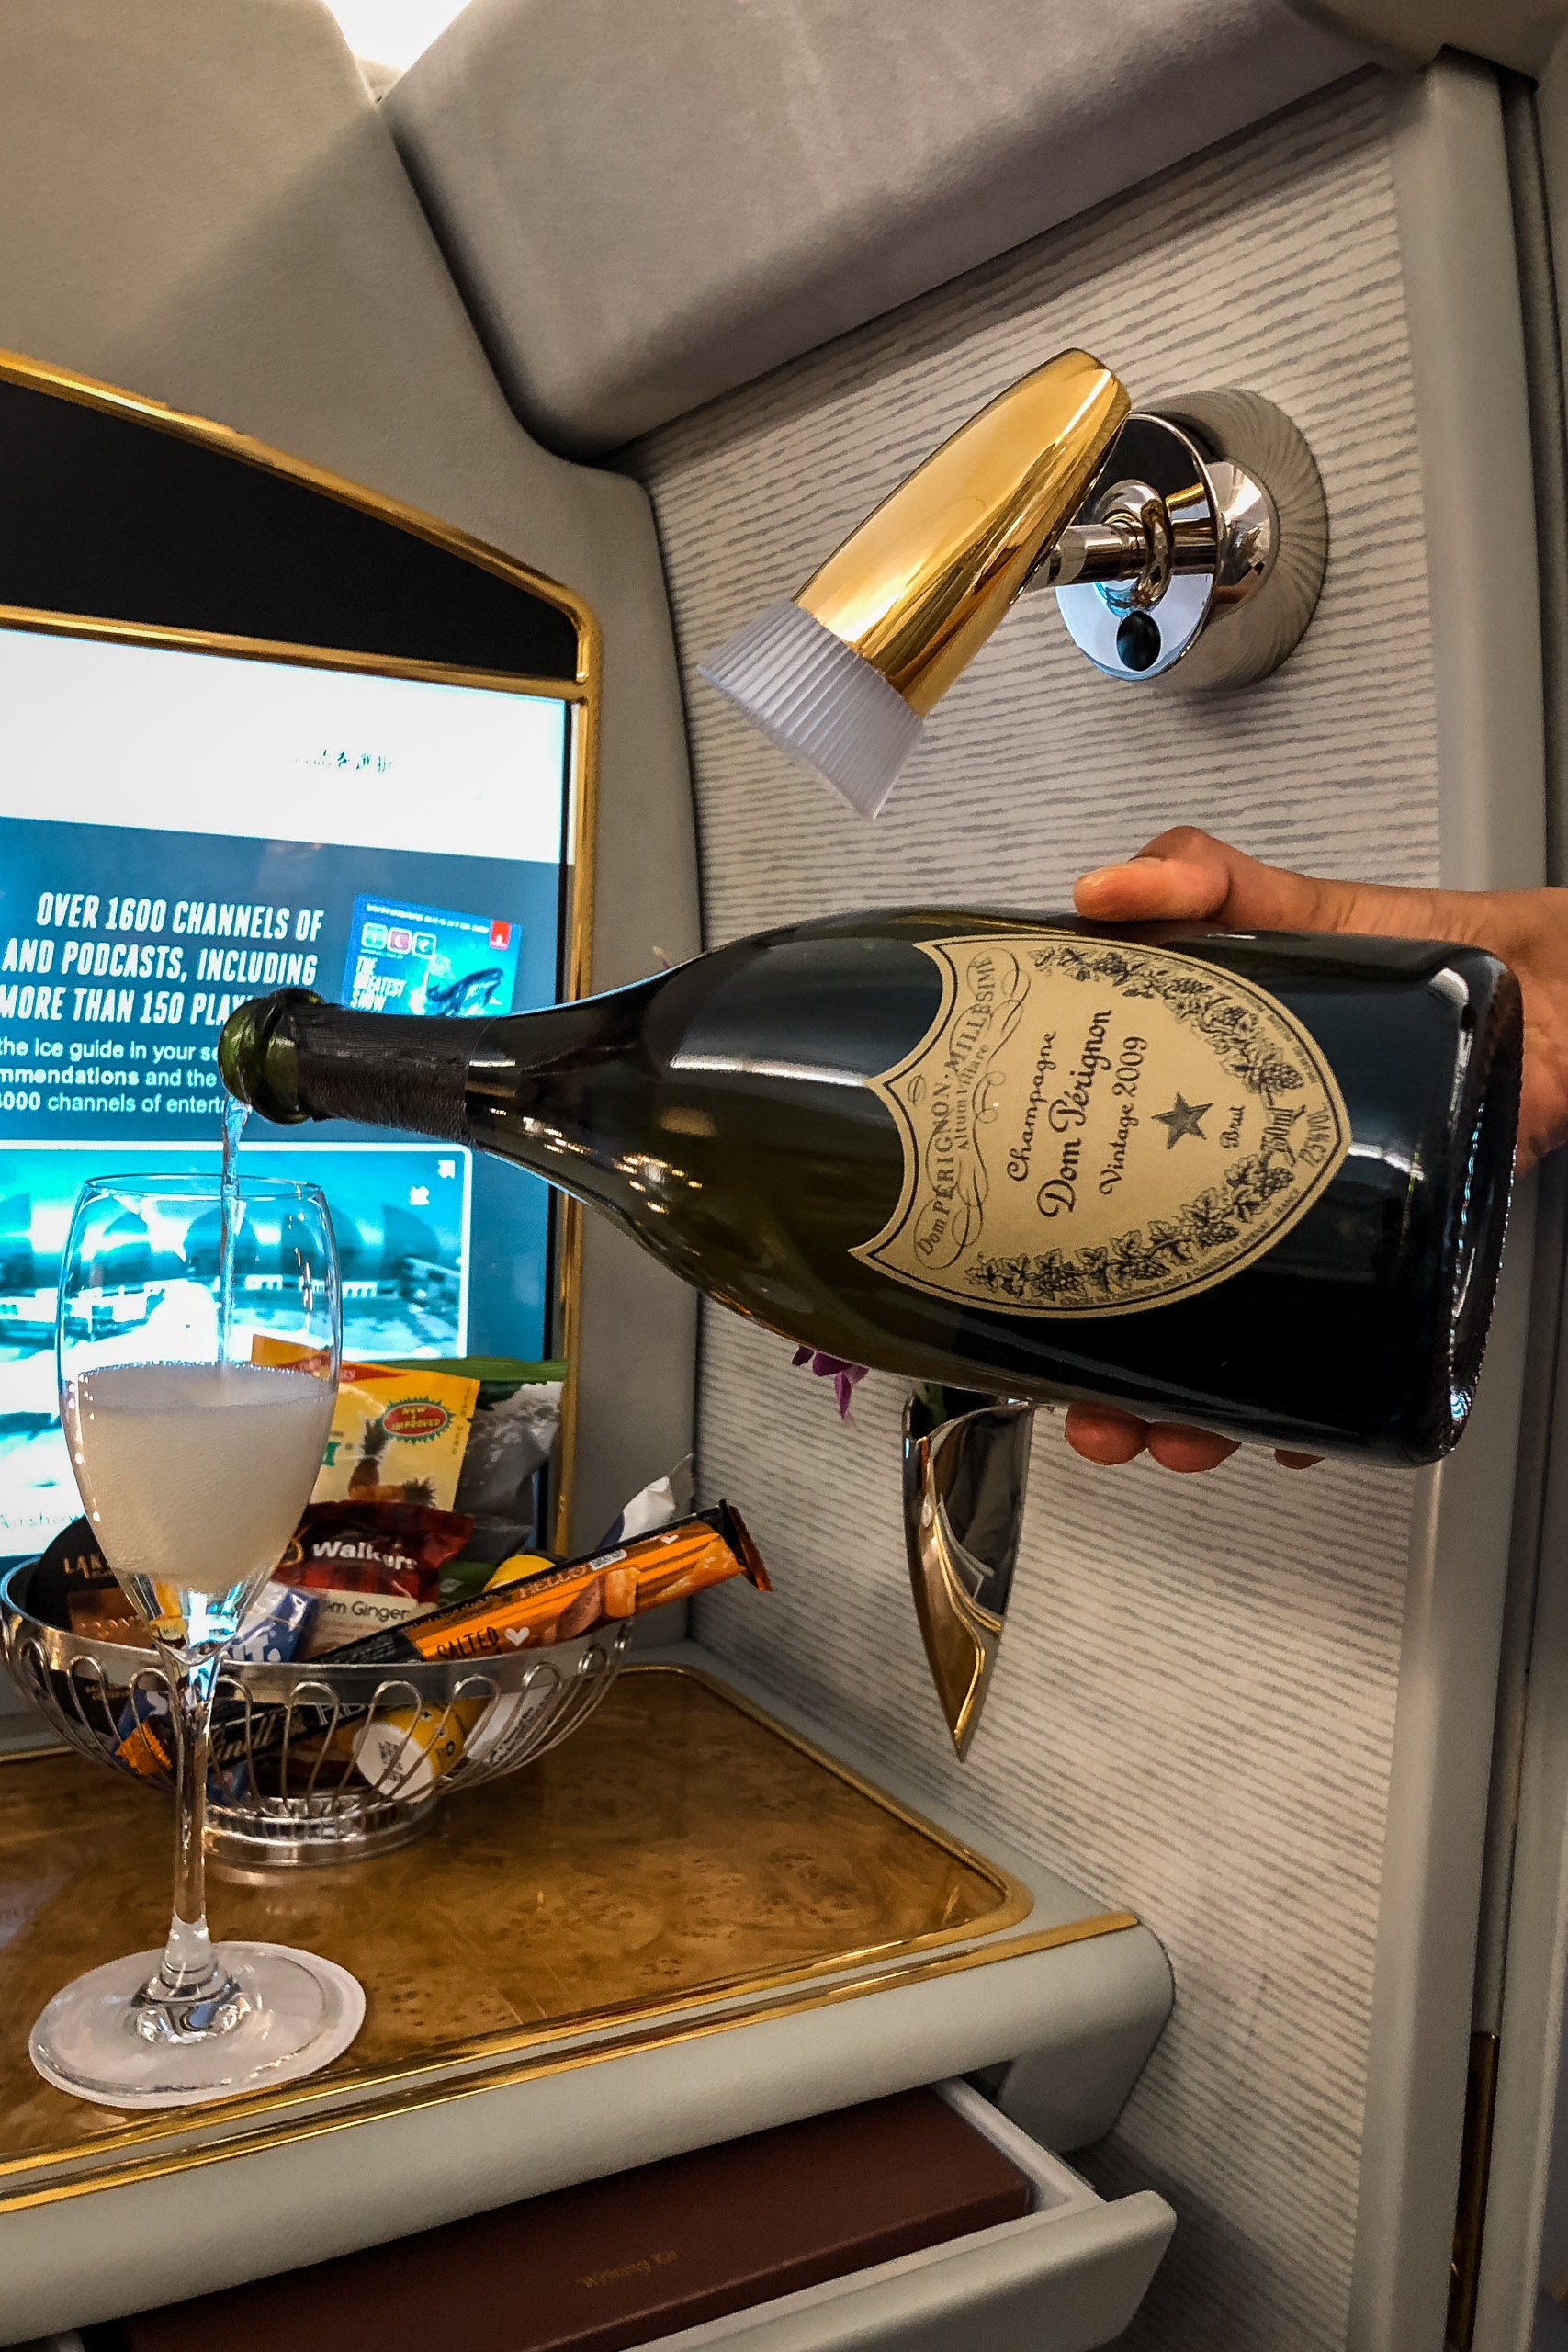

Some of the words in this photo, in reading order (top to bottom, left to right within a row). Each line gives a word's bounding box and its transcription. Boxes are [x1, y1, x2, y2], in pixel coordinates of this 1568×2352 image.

[37, 892, 100, 929] OVER
[106, 896, 167, 933] 1600
[172, 900, 290, 941] CHANNELS
[295, 909, 325, 943] OF
[1, 937, 55, 974] AND
[61, 941, 189, 984] PODCASTS,
[197, 947, 319, 986] INCLUDING
[0, 983, 67, 1021] MORE
[73, 987, 135, 1023] THAN
[140, 990, 185, 1026] 150
[190, 992, 254, 1026] PLAY
[70, 1039, 125, 1062] guide
[130, 1041, 148, 1060] in
[153, 1046, 196, 1064] your
[1048, 1009, 1112, 1135] Pérignon
[1111, 1035, 1148, 1099] 2009
[145, 1069, 182, 1088] and
[187, 1069, 218, 1088] the
[0, 1091, 41, 1111] 000
[48, 1091, 136, 1113] channels
[141, 1093, 161, 1114] of
[166, 1095, 226, 1114] entert
[1006, 1030, 1056, 1182] Champagne
[1219, 1104, 1247, 1149] Brut
[1098, 1102, 1139, 1196] Vintage
[1036, 1137, 1083, 1219] Dom
[917, 1218, 946, 1257] Dom
[311, 1540, 419, 1571] Walkers
[351, 1600, 411, 1623] Ginger
[436, 1626, 500, 1661] SALTED
